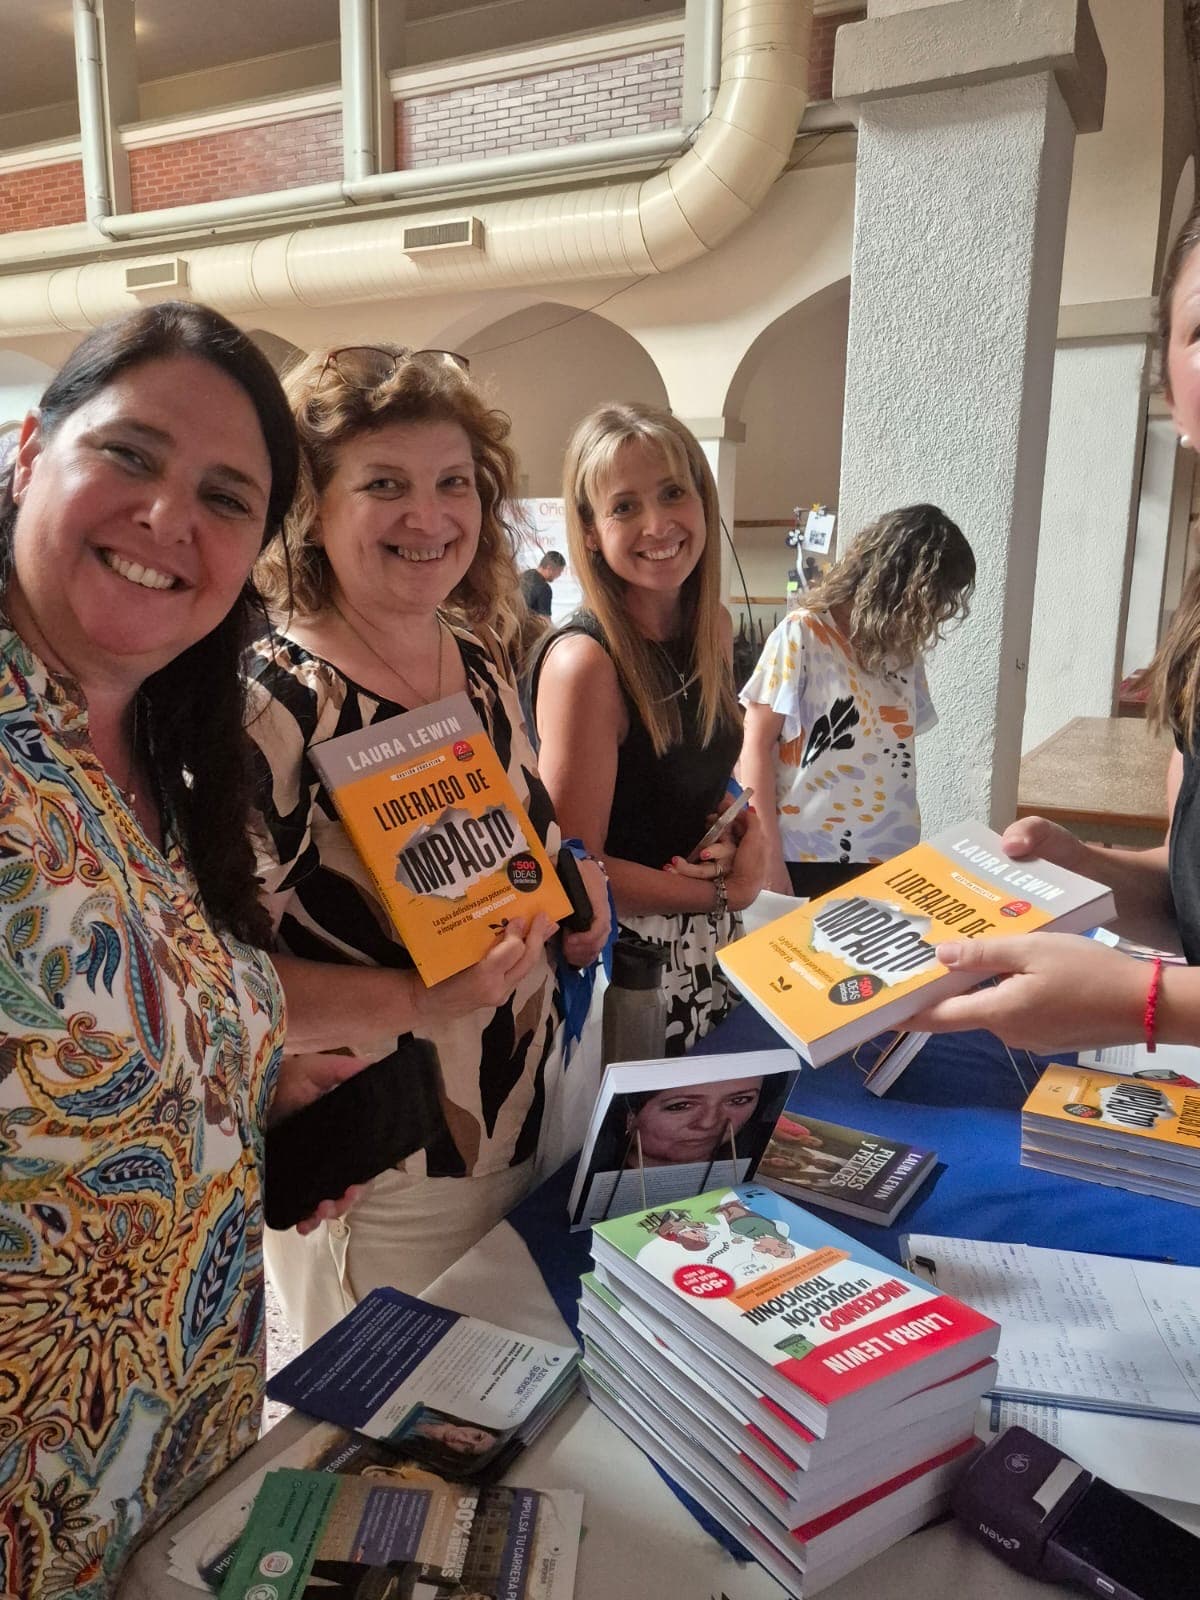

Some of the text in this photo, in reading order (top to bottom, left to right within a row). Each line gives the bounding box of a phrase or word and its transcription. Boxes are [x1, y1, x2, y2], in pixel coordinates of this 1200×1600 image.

[346, 716, 462, 772] LAURA LEWIN
[373, 775, 466, 832] LIDERAZGO
[465, 768, 490, 794] DE
[400, 808, 515, 895] IMPACTO
[951, 838, 1065, 901] LAURA LEWIN
[512, 870, 537, 879] IDEAS
[884, 868, 997, 939] LIDERAZGO DE
[814, 897, 936, 973] IMPACTO
[847, 980, 861, 1001] IDEAS
[1106, 1083, 1166, 1128] IMPACTO
[830, 1149, 875, 1187] FELICES
[847, 1148, 896, 1190] FUERTES
[873, 1153, 922, 1200] LAURA LEWIN
[691, 1278, 728, 1295] +500
[739, 1275, 835, 1327] TRADICIONAL
[781, 1278, 872, 1329] LA EDUCACIÓN
[819, 1279, 911, 1332] HACKEANDO
[883, 1312, 954, 1347] LAURA
[822, 1337, 893, 1375] LEWIN
[323, 1443, 362, 1475] ESIONAL
[452, 1497, 479, 1536] 50%
[518, 1496, 533, 1533] IMPULSA
[516, 1535, 527, 1547] TU
[213, 1551, 236, 1574] IMP
[508, 1548, 525, 1590] CARRERA
